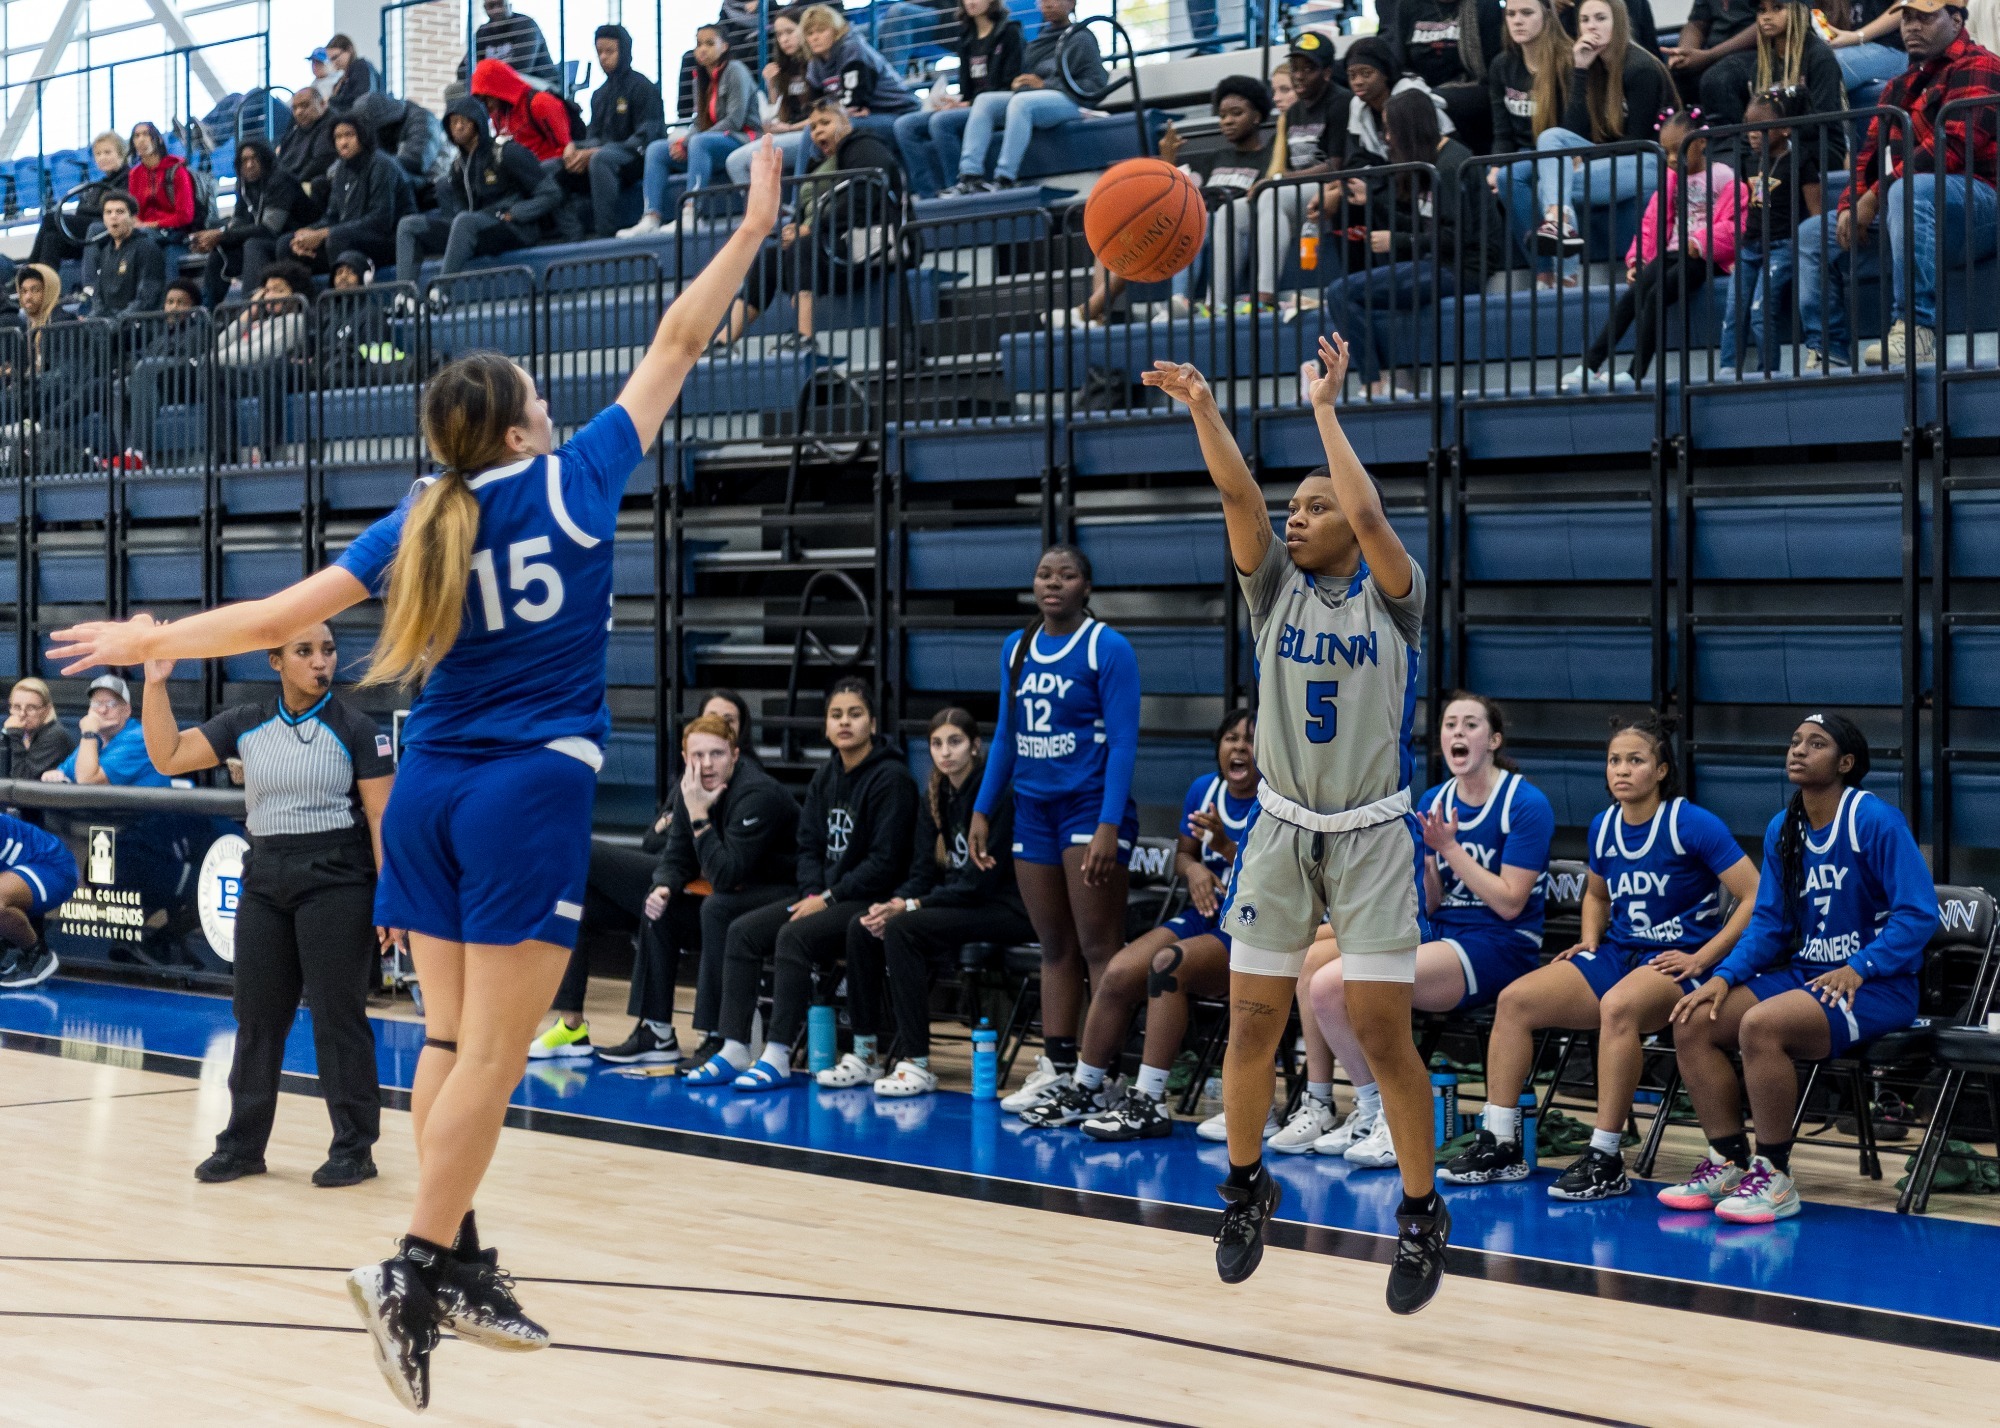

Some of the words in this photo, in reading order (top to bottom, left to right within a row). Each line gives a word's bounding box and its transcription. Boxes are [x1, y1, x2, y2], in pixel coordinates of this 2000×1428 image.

[470, 536, 564, 631] 15
[1278, 623, 1379, 670] BLINN
[1023, 698, 1052, 733] 12
[1305, 680, 1339, 744] 5
[1015, 731, 1076, 759] ESTERNERS
[1435, 841, 1497, 870] LDY
[96, 889, 140, 905] COLLEGE
[1606, 871, 1671, 901] LADY
[60, 902, 97, 921] ALUMNI
[106, 906, 144, 926] FRIENDS
[1627, 900, 1651, 932] 5
[61, 922, 142, 942] ASSOCIATION
